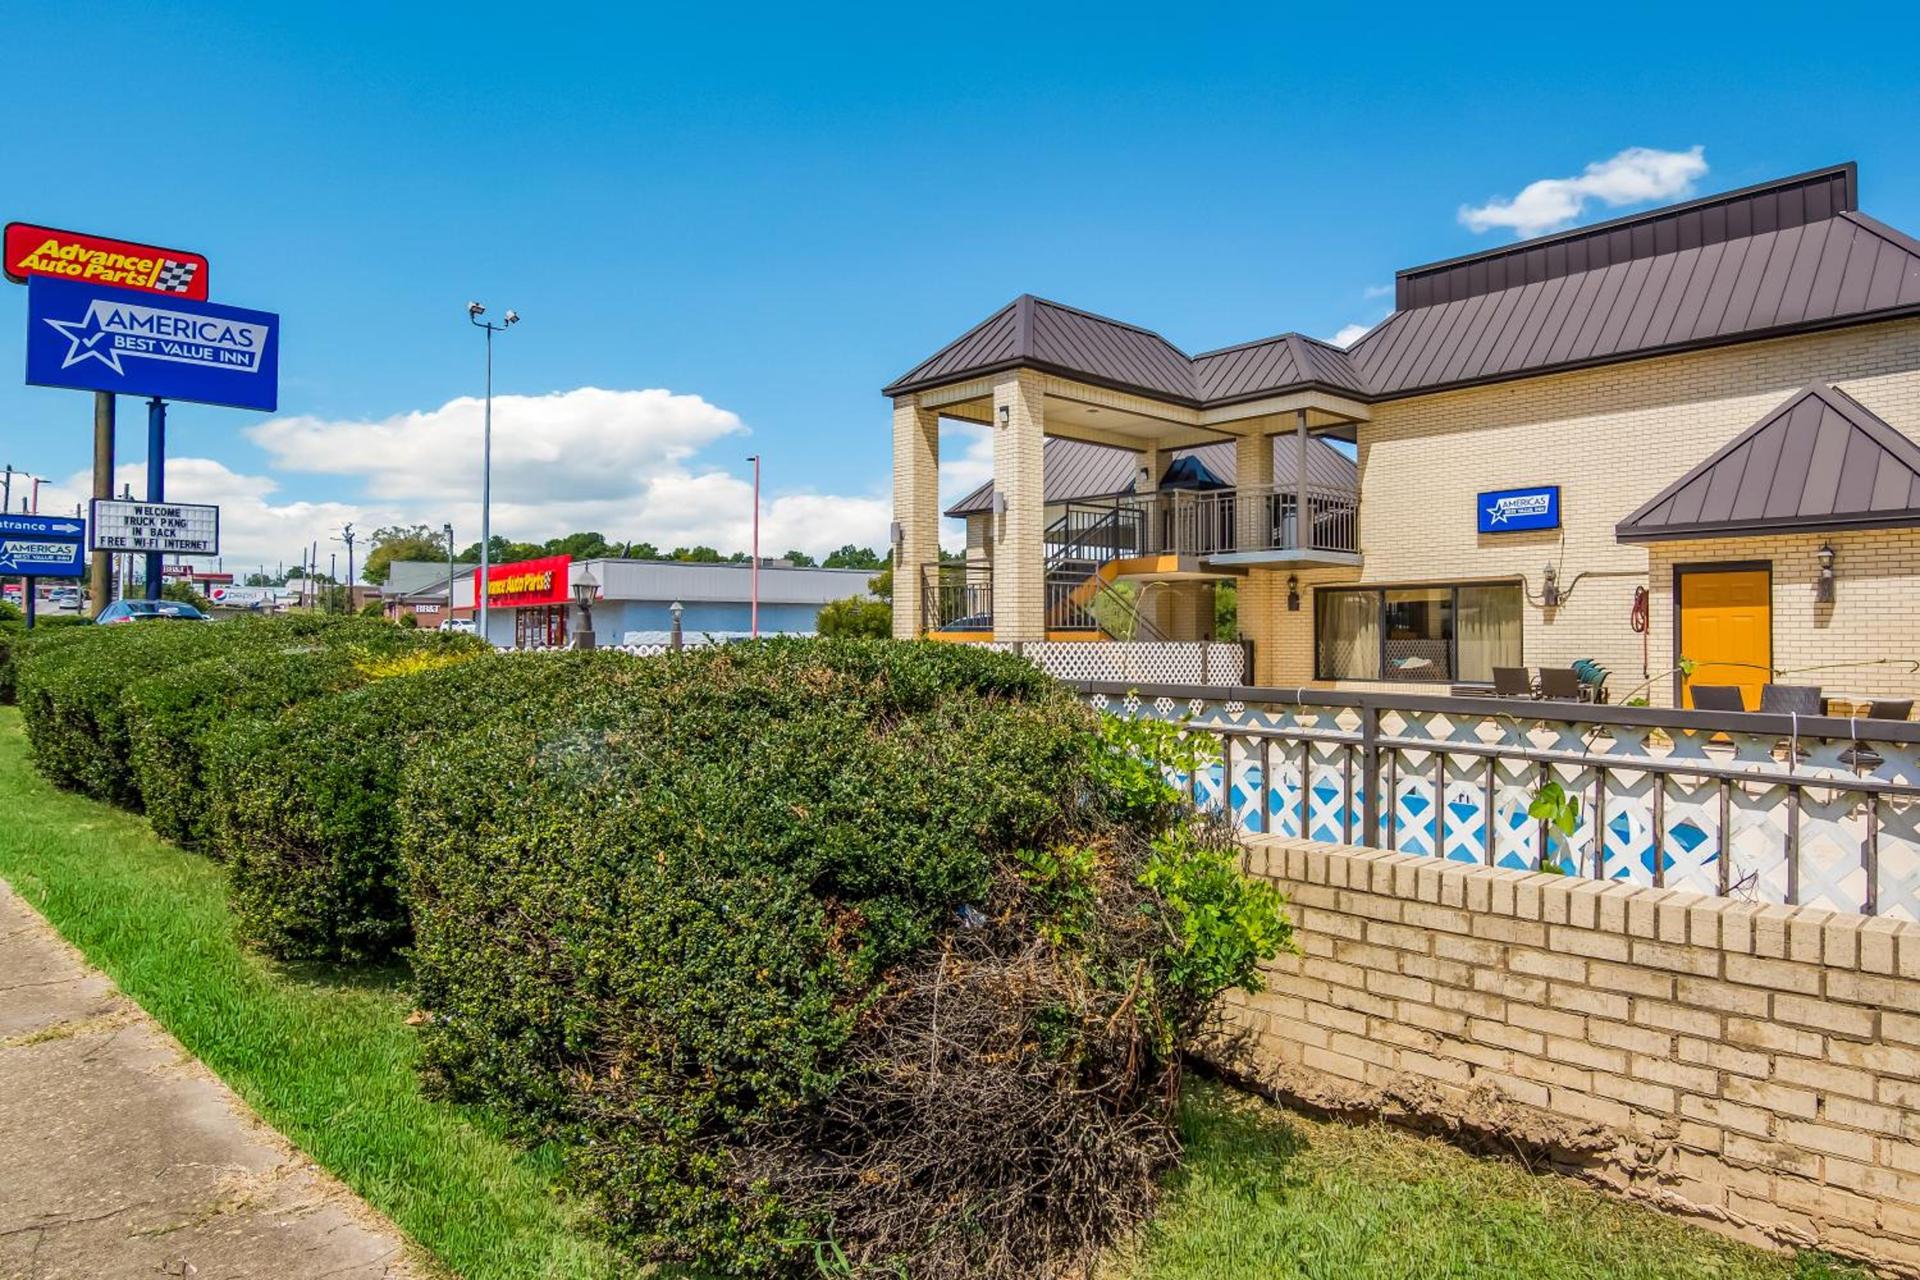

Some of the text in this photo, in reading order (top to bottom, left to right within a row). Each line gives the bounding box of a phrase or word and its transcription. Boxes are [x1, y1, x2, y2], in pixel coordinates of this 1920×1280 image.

[34, 239, 151, 272] Advance
[17, 254, 148, 287] Auto Parts
[105, 309, 253, 347] AMERICAS
[114, 336, 249, 365] BEST VALUE INN
[1502, 497, 1546, 508] AMERICAS
[134, 506, 181, 517] WELCOME
[124, 516, 155, 526] TRUCK
[132, 527, 176, 538] IN BACK
[10, 544, 71, 554] AMERICAS
[100, 536, 208, 550] FREE WI-FI INTERNET
